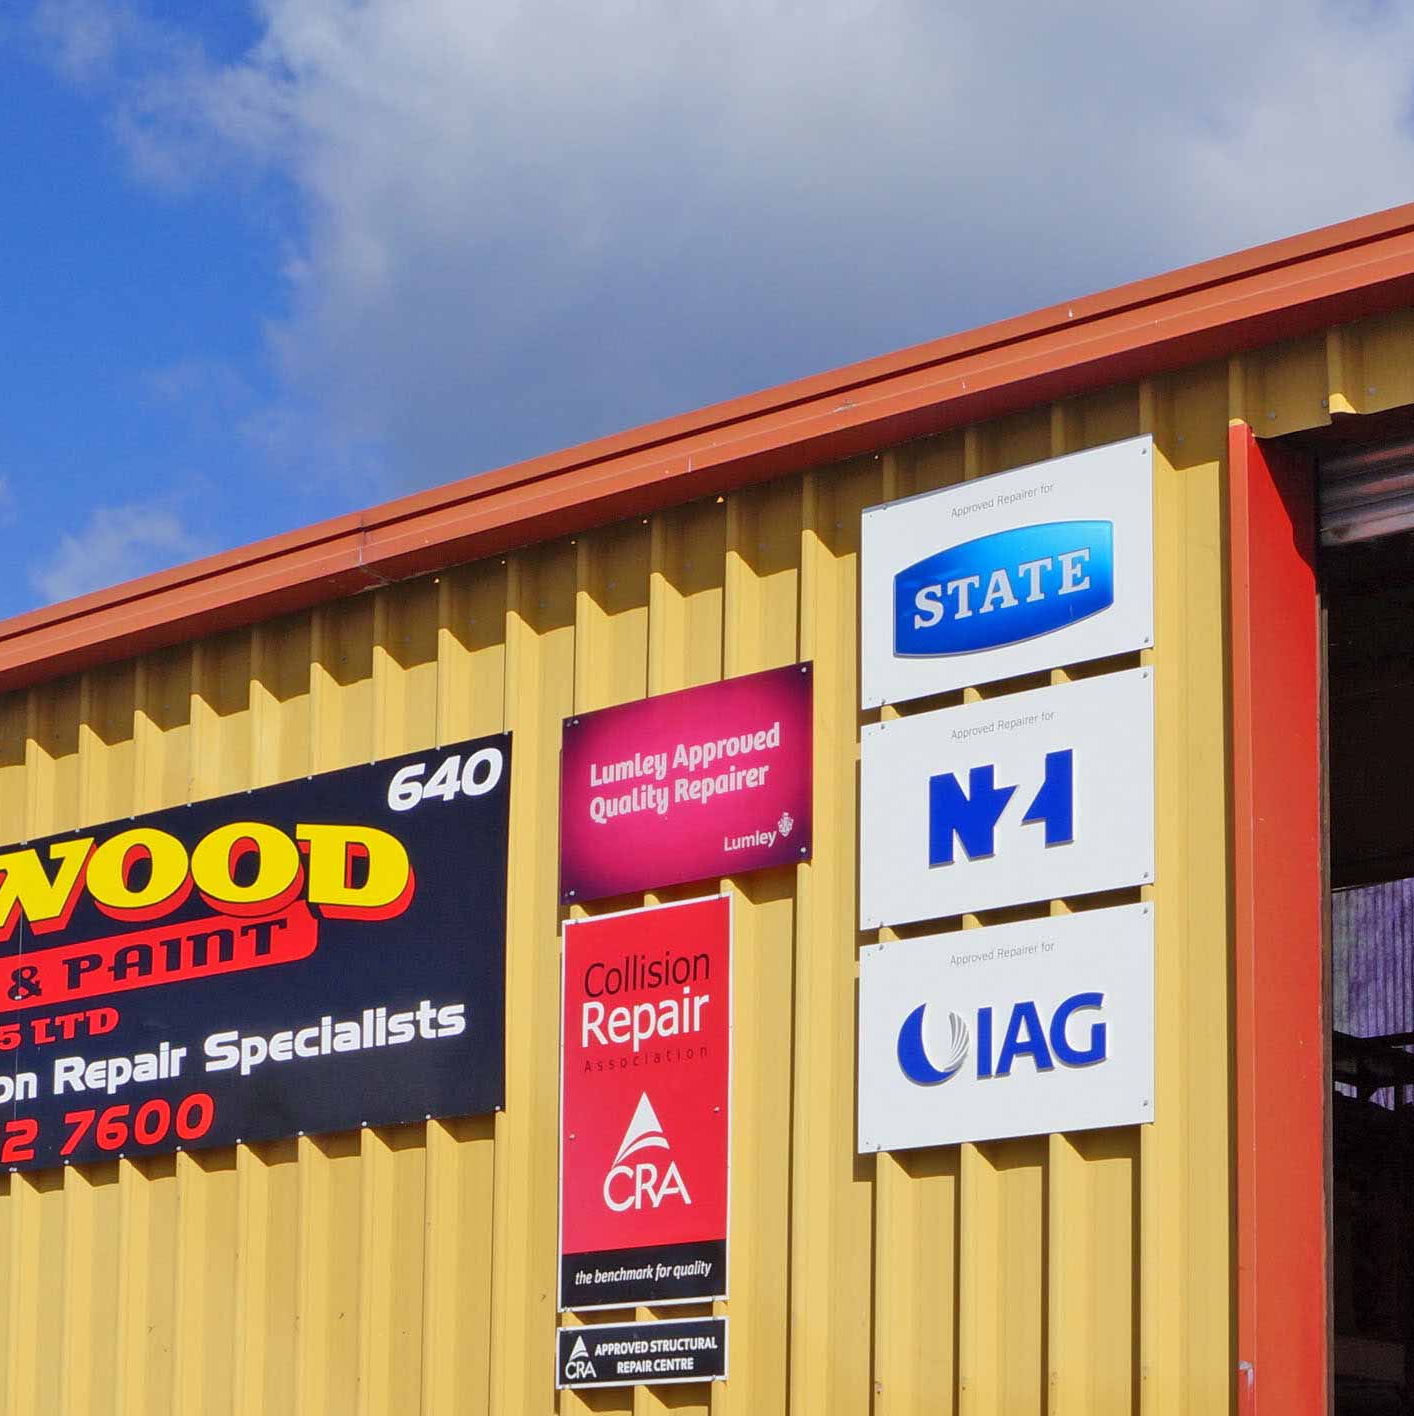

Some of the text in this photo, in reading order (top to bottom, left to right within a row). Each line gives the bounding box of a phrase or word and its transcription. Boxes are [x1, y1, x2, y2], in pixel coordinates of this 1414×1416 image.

[950, 482, 1054, 519] Approved Repairer for
[914, 547, 1091, 630] STATE
[950, 711, 1055, 740] Approved Repairer for
[589, 722, 780, 787] Lumley Approved
[387, 746, 504, 812] 640
[589, 764, 770, 824] Quality Repairer
[723, 830, 777, 852] Lumley
[6, 964, 43, 1001] &
[62, 918, 286, 990] PAINT
[584, 950, 711, 998] Collision
[950, 941, 1055, 968] Approved Repairer for
[29, 1006, 120, 1045] LTD
[581, 985, 710, 1053] Repair
[976, 991, 1107, 1081] IAG
[53, 1041, 187, 1095] Repair
[203, 1000, 467, 1076] Specialists
[583, 1045, 708, 1073] Association
[59, 1092, 216, 1157] 7600
[603, 1160, 692, 1212] CRA
[575, 1259, 713, 1286] the benchmark for quality
[564, 1361, 597, 1380] CRA
[595, 1336, 718, 1357] APPROVED STRUCTURAL
[616, 1357, 695, 1374] REPAIR CENTRE
